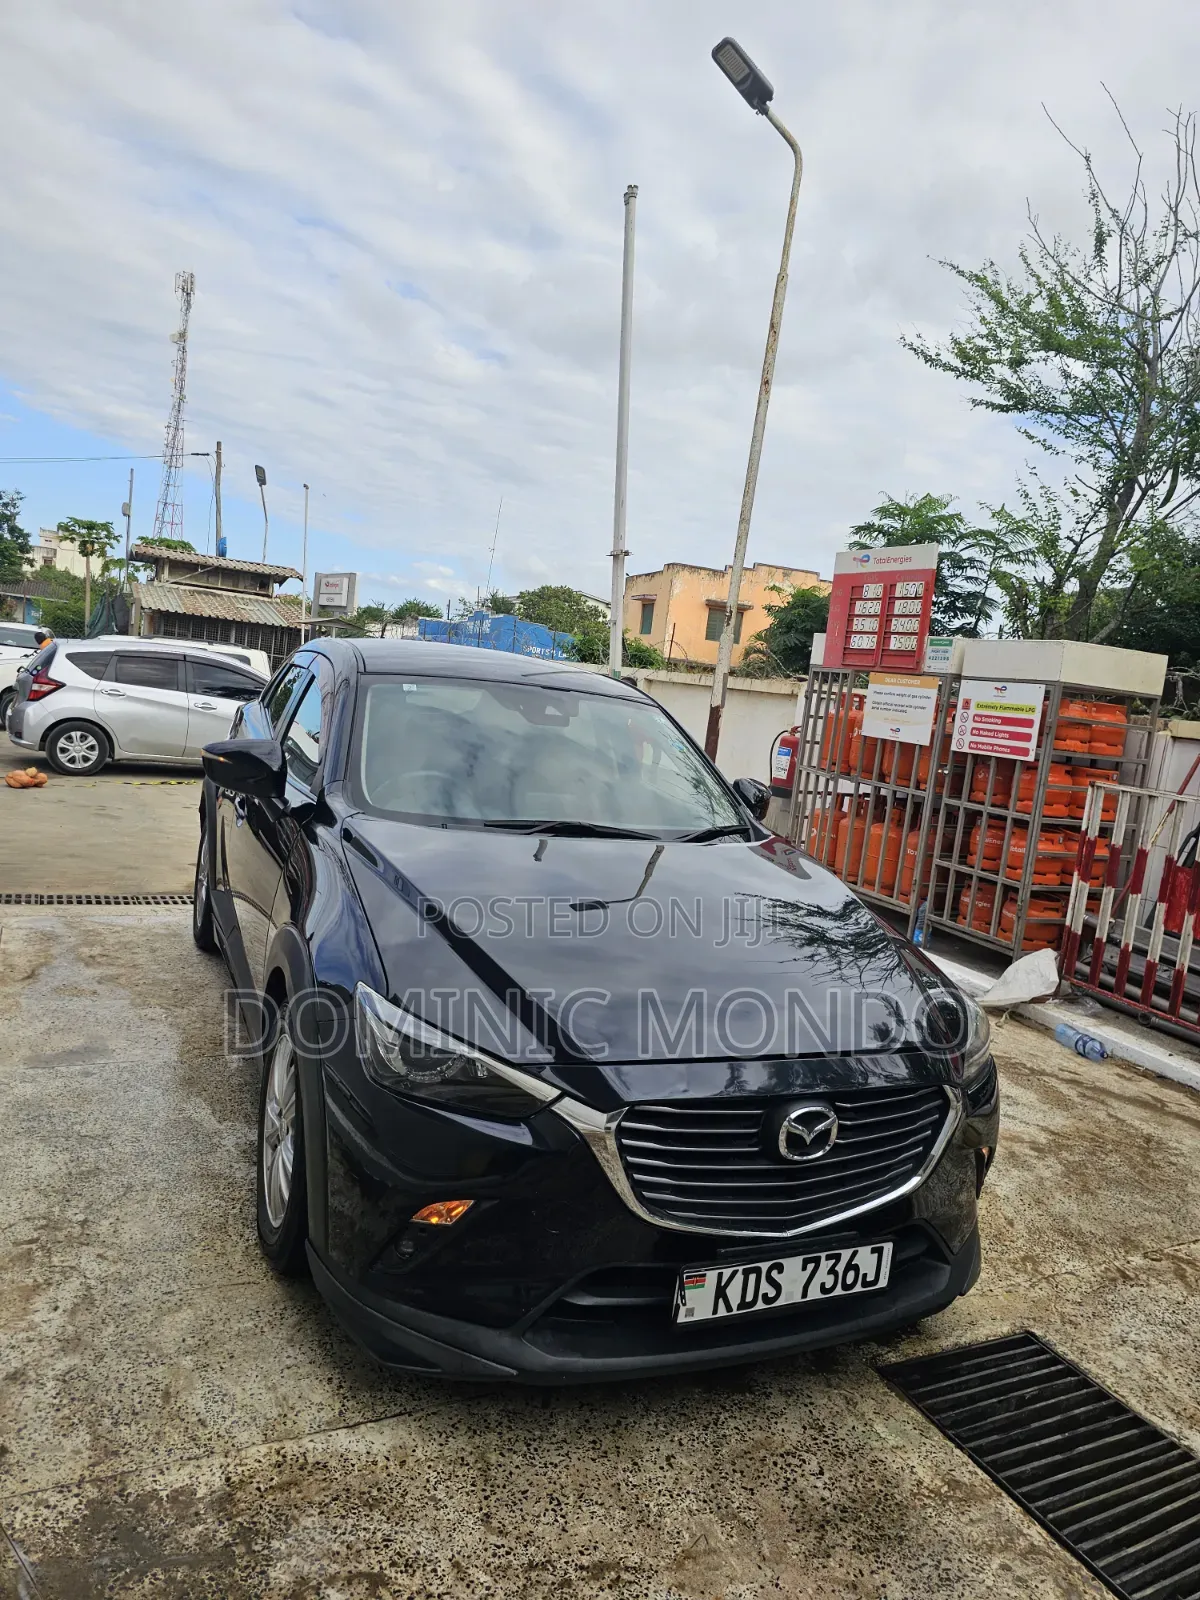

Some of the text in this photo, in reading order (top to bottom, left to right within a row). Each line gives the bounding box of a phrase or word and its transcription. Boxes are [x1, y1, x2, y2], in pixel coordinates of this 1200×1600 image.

[873, 555, 912, 565] TotalEnergies
[899, 582, 924, 596] 1500
[857, 601, 881, 614] 1620
[898, 600, 922, 614] 1800
[854, 619, 878, 631] 3510
[892, 618, 919, 632] 3400
[850, 635, 876, 648] 6075
[893, 636, 918, 650] 7500
[999, 704, 1025, 712] Flammable
[982, 716, 1002, 724] Smoking
[994, 731, 1009, 739] Lights
[993, 745, 1011, 753] Phones
[711, 1261, 785, 1316] KDS
[800, 1245, 885, 1300] 736J
